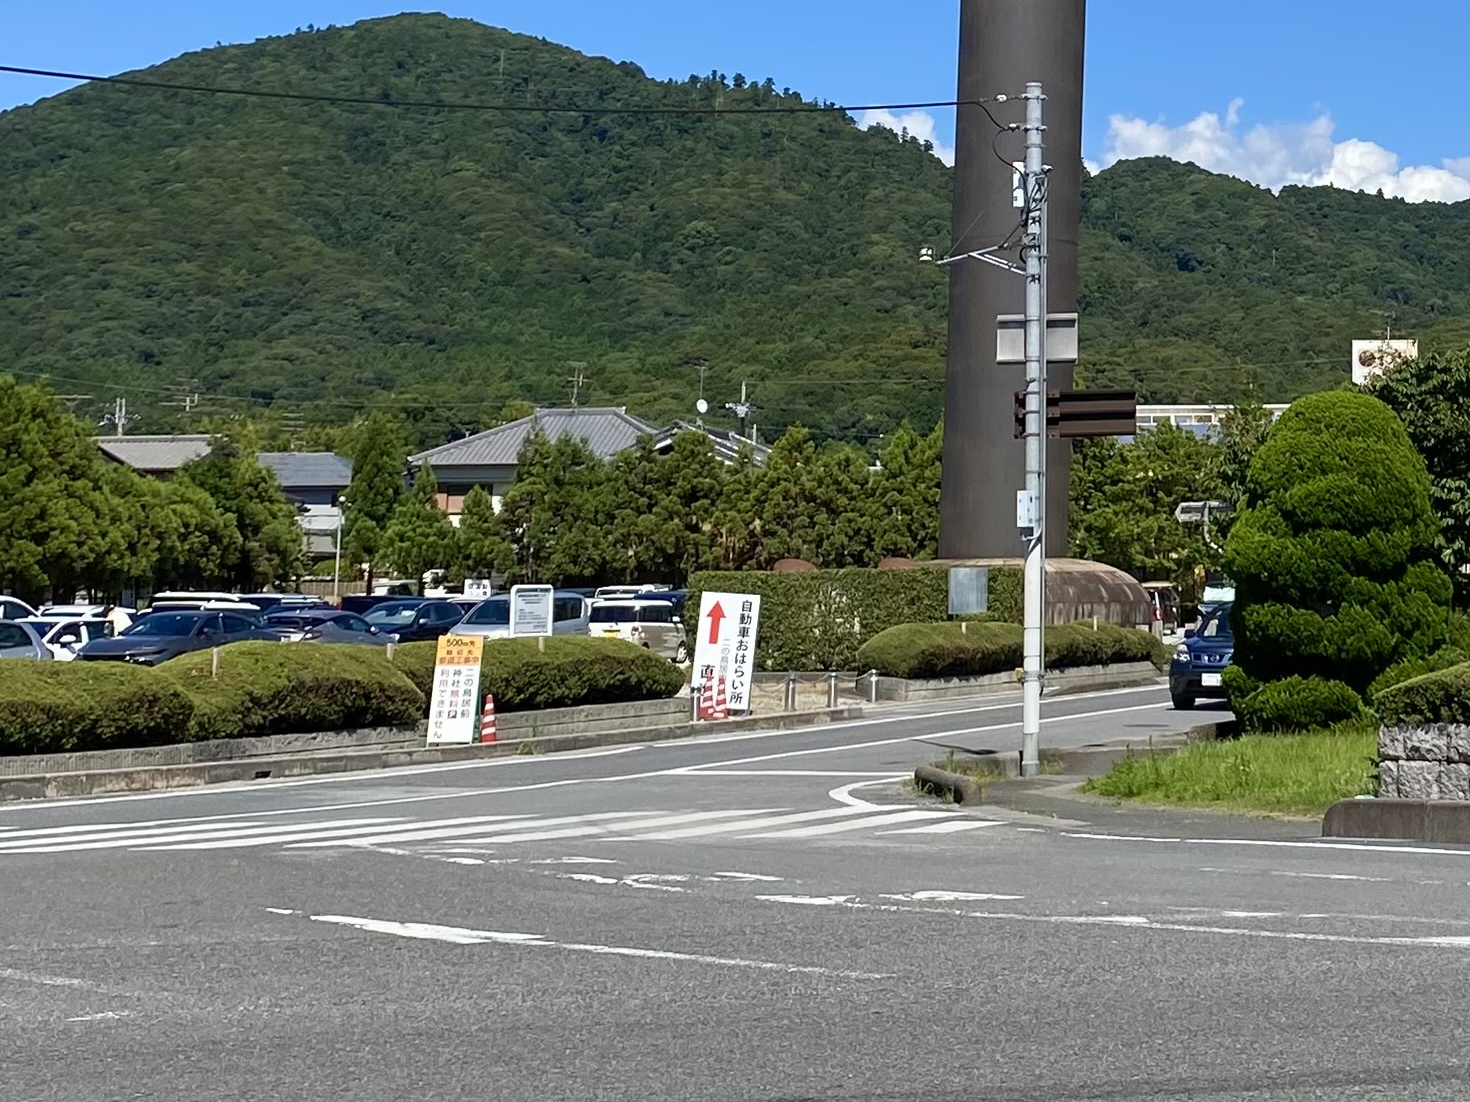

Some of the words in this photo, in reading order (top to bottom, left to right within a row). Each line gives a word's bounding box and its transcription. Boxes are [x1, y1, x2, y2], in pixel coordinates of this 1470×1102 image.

[729, 600, 753, 704] 自動車おはらい所
[433, 668, 449, 739] 利用できません
